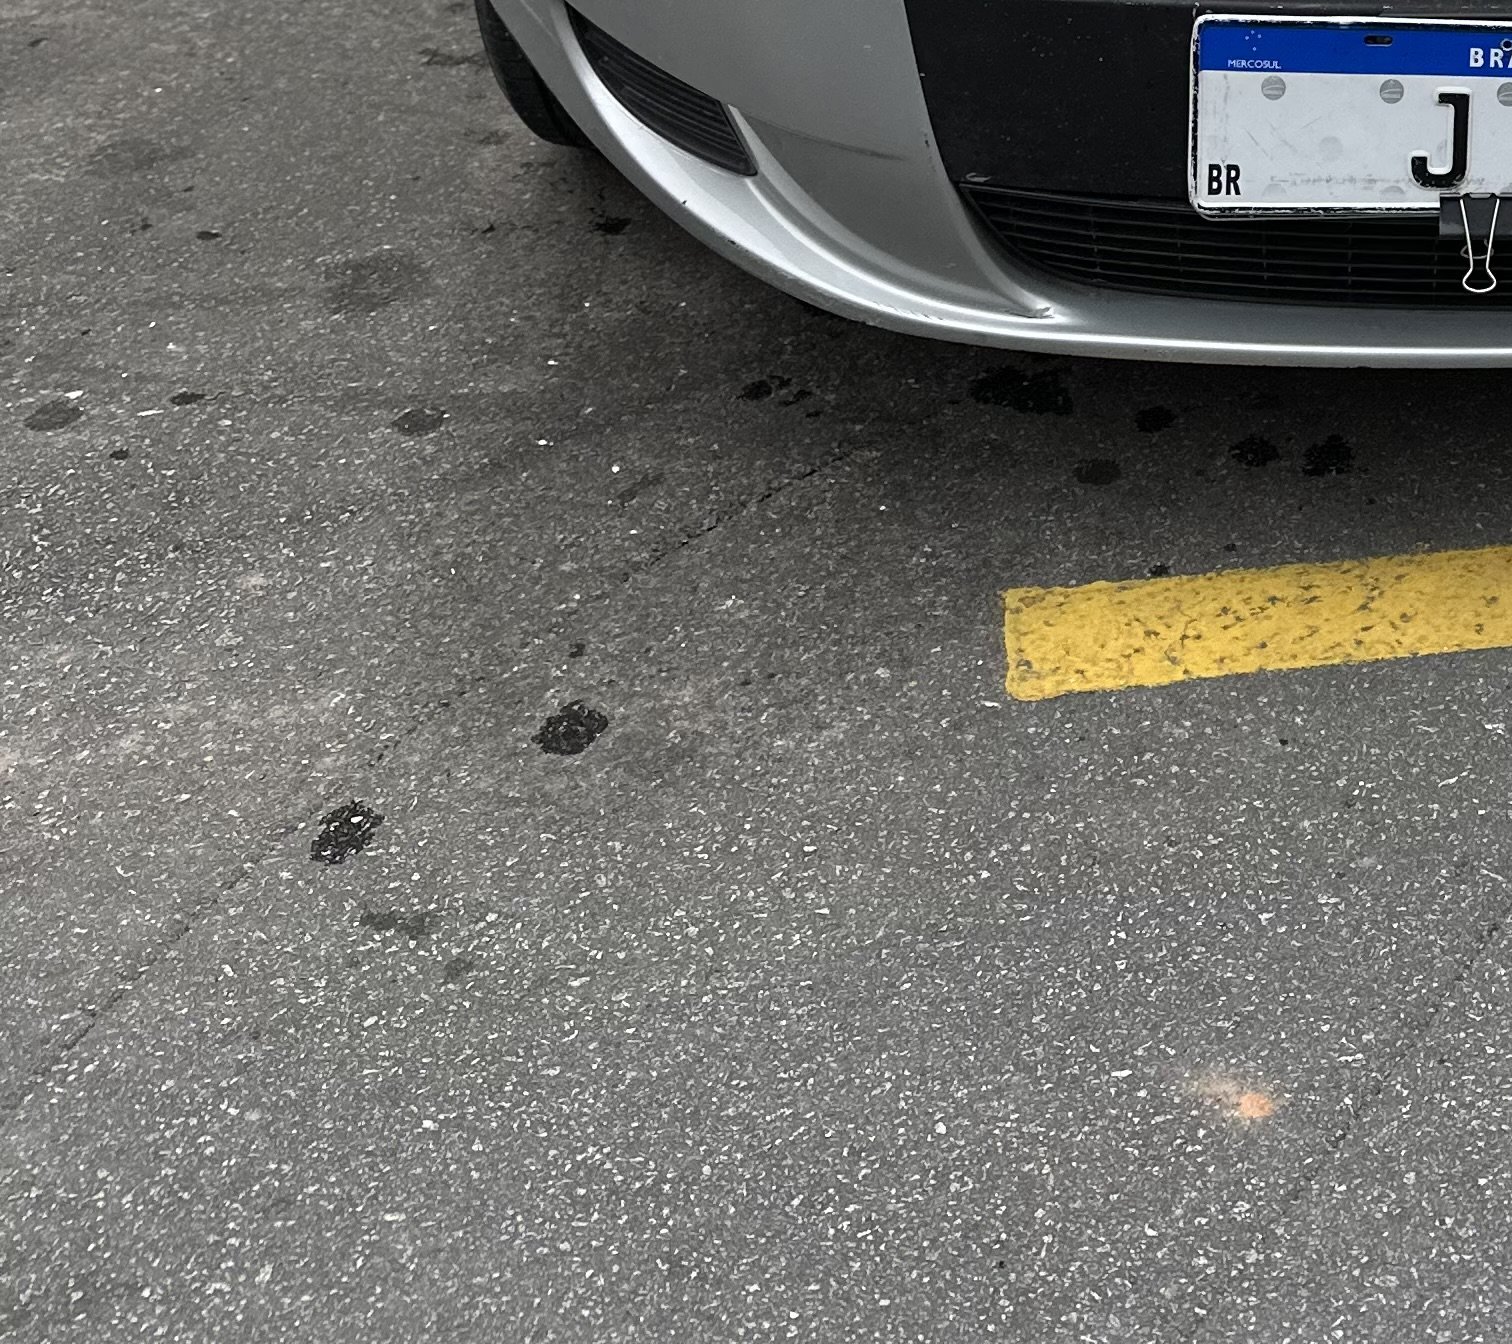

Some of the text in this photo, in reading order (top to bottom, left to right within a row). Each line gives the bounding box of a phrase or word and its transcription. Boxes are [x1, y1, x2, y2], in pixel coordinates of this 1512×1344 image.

[1227, 59, 1282, 70] MERCOSUL
[1408, 86, 1473, 192] J
[1207, 163, 1242, 196] BR
